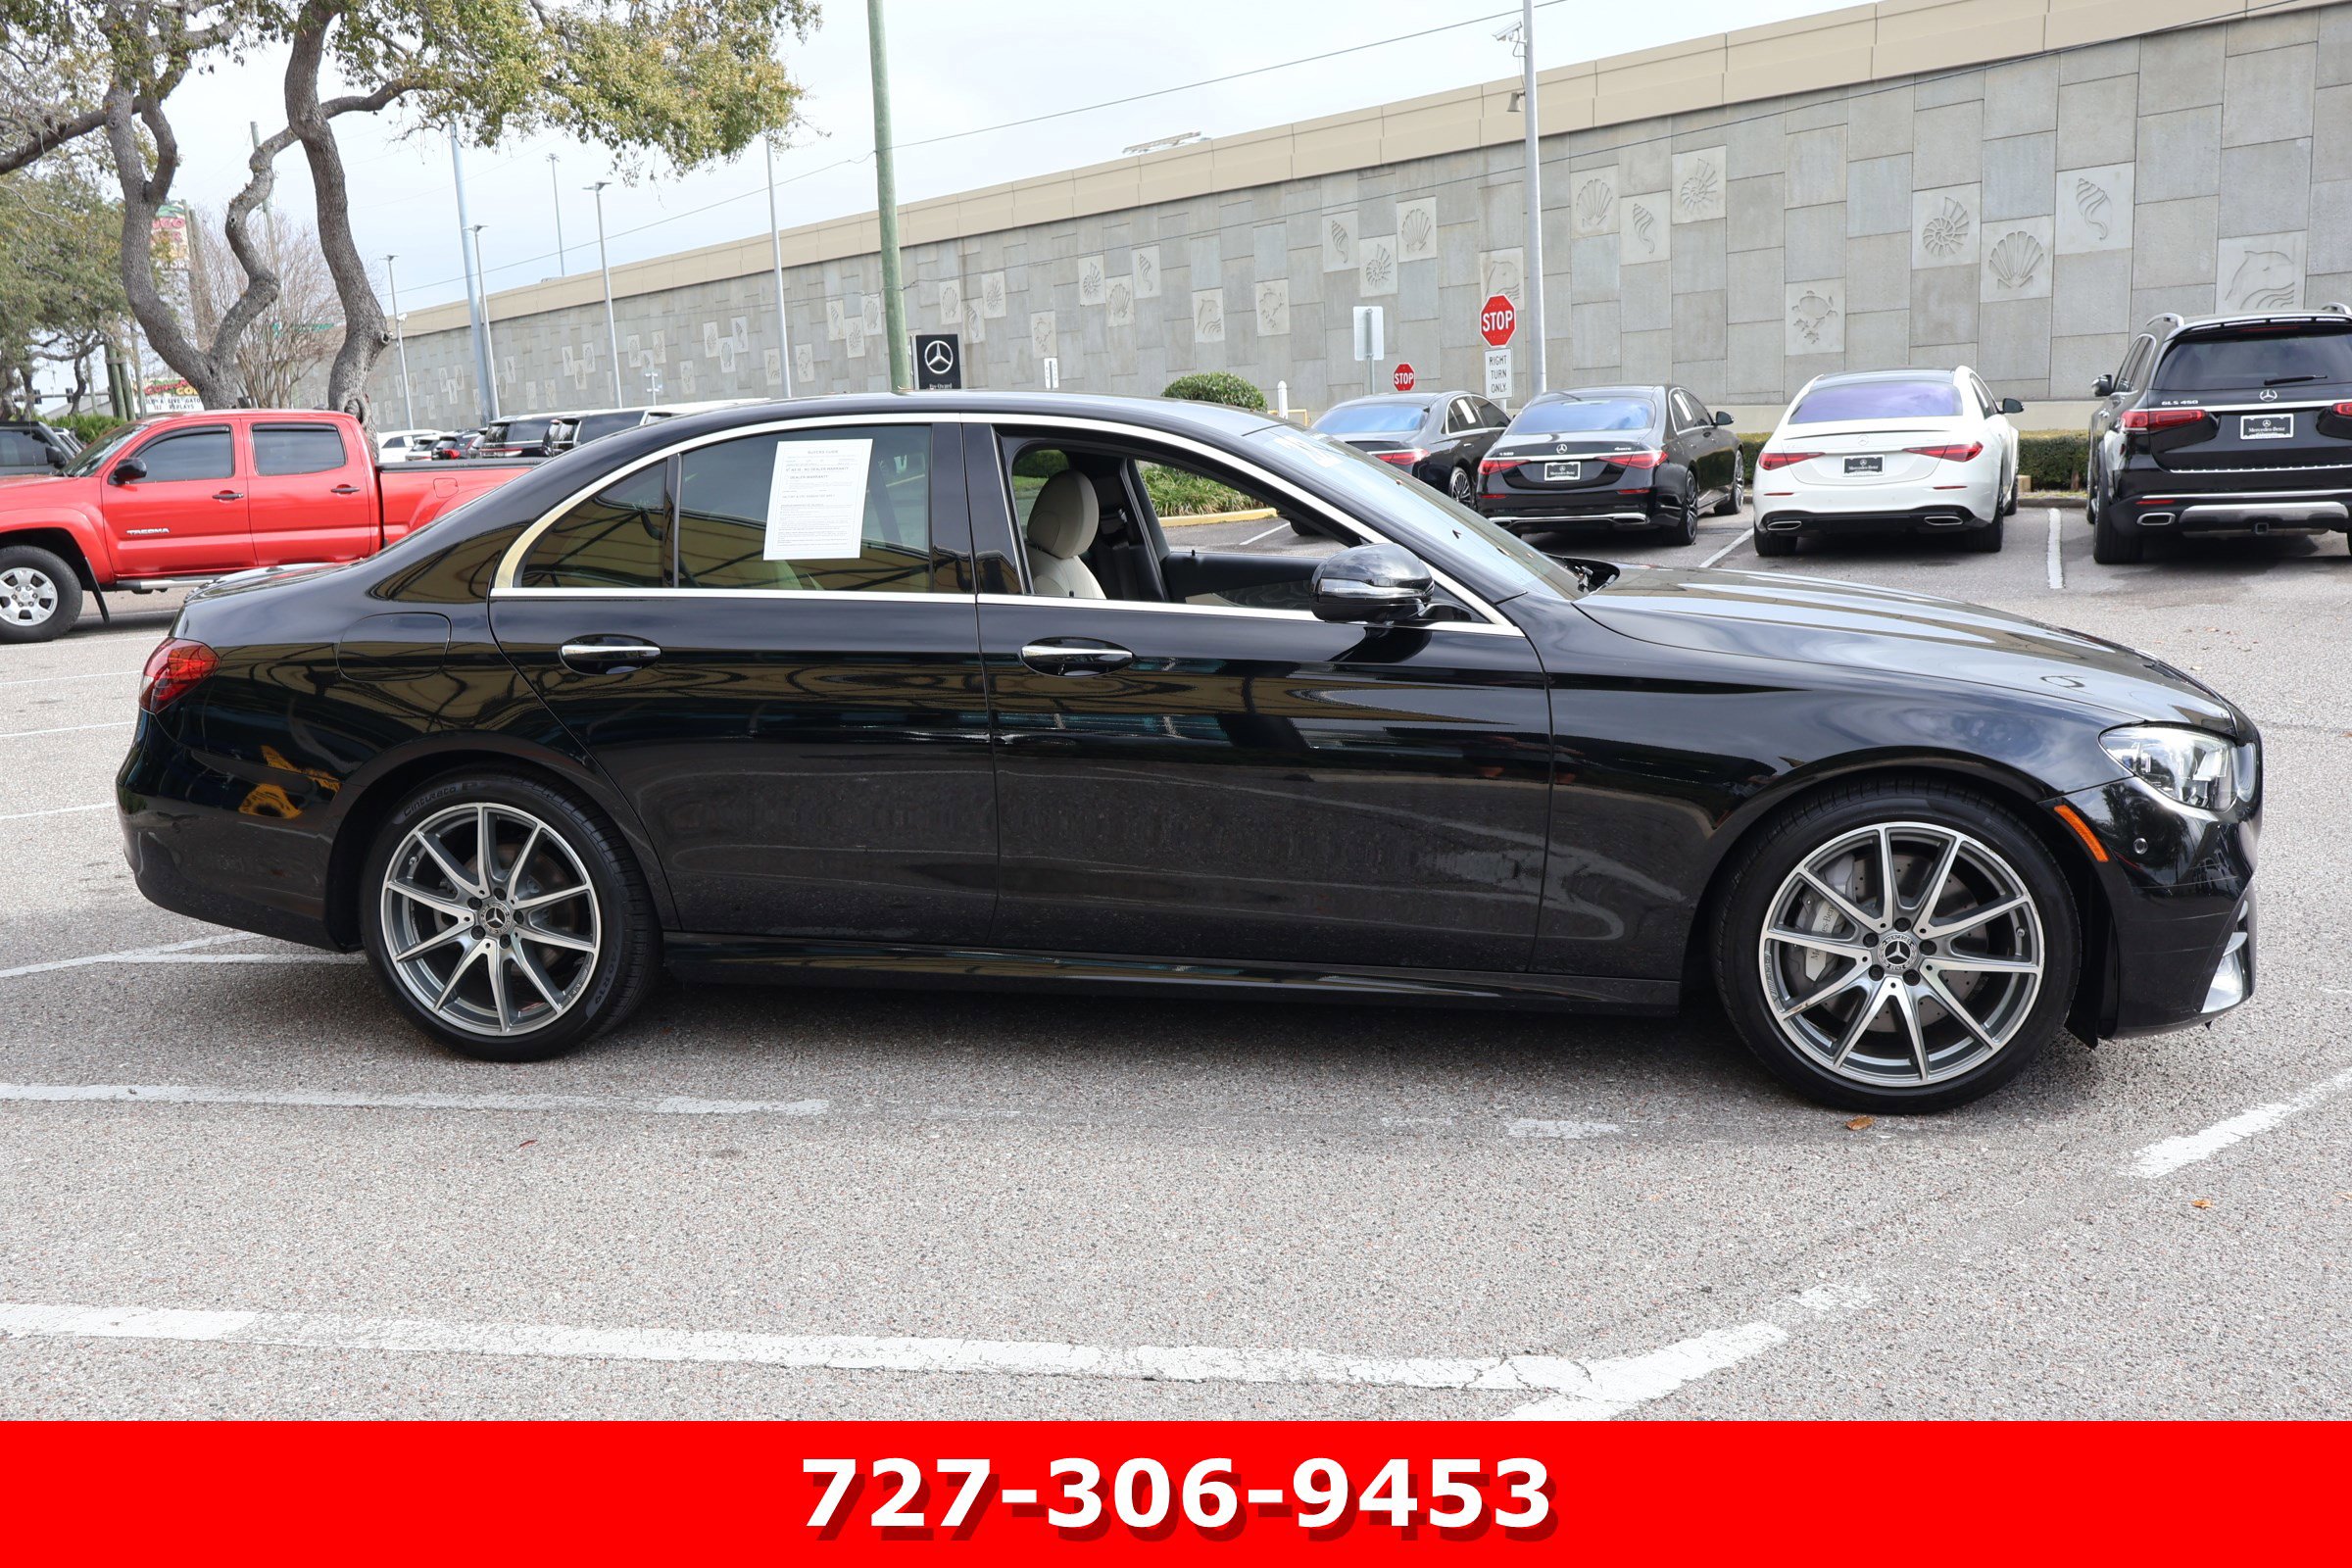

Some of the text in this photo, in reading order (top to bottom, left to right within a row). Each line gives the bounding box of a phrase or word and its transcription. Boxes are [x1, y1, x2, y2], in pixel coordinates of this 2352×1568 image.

[1482, 311, 1513, 332] STOP
[1490, 355, 1507, 366] RIGHT
[1394, 372, 1414, 385] STOP
[1491, 369, 1507, 379] TURN
[1491, 383, 1507, 393] ONLY
